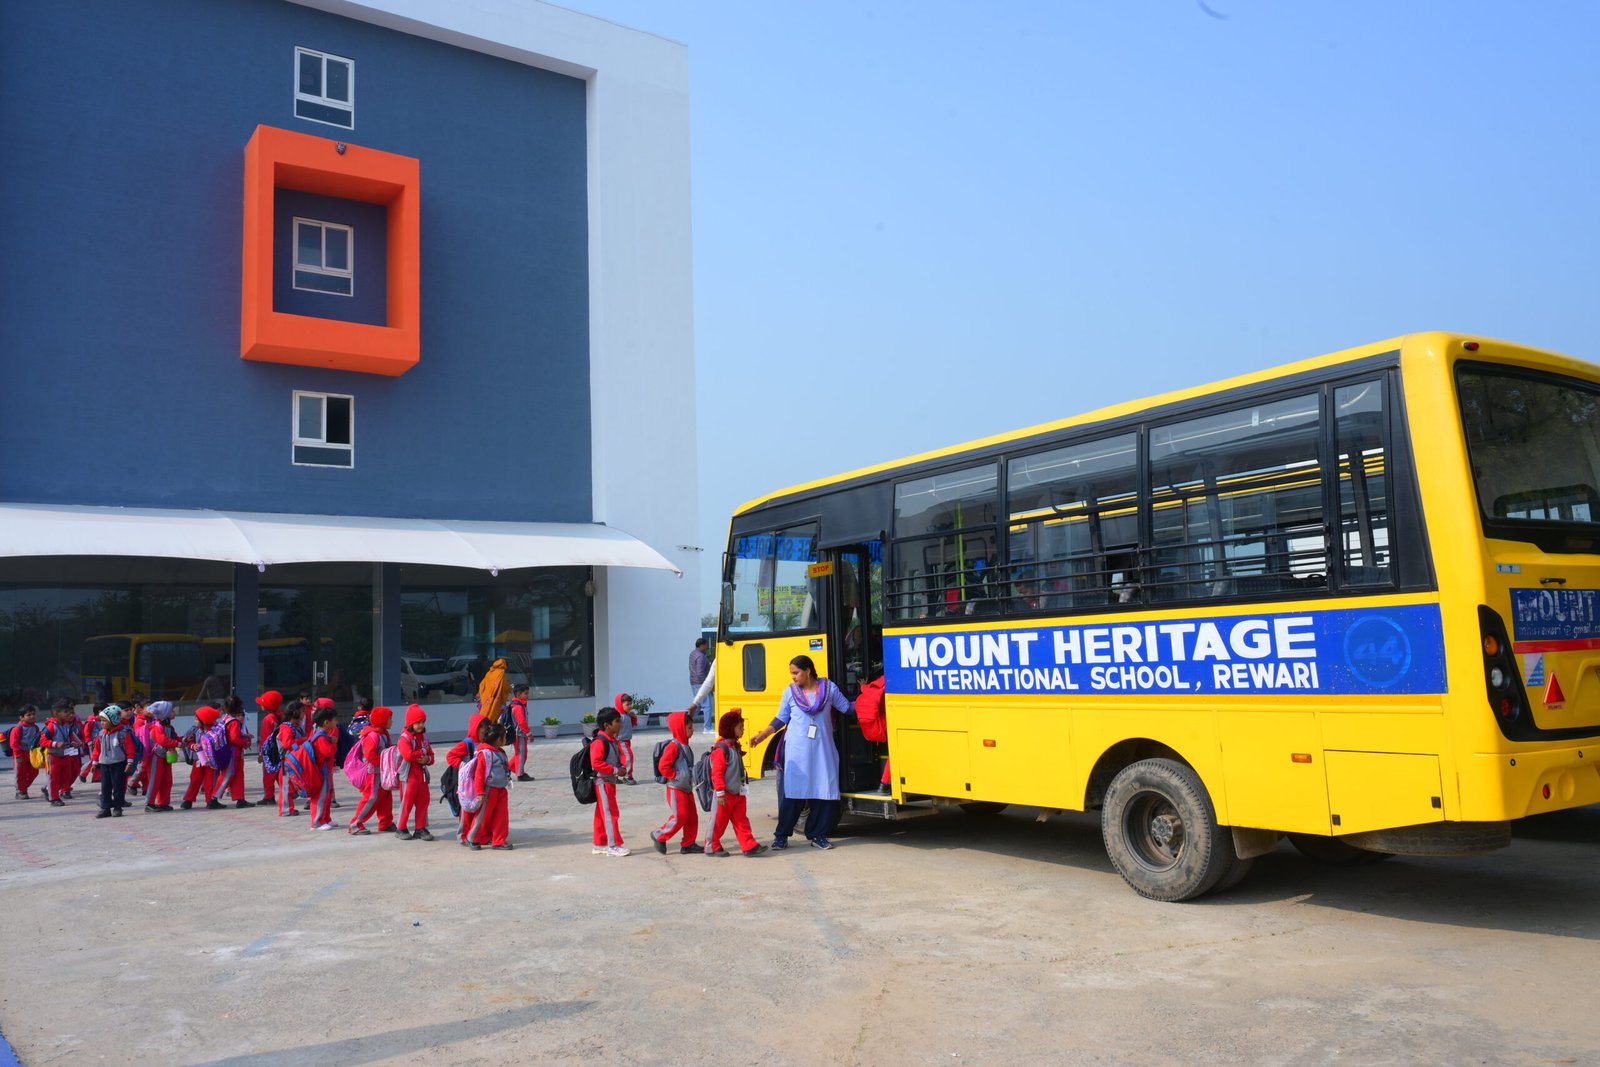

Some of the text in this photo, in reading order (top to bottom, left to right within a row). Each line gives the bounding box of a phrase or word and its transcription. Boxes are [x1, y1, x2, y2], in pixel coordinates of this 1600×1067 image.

[812, 564, 829, 574] STOP
[1517, 590, 1595, 622] MOUNT
[900, 616, 1317, 668] MOUNT HERITAGE
[1353, 634, 1403, 665] 44
[915, 667, 1079, 690] INTERNATIONAL
[1212, 662, 1319, 689] REWARI
